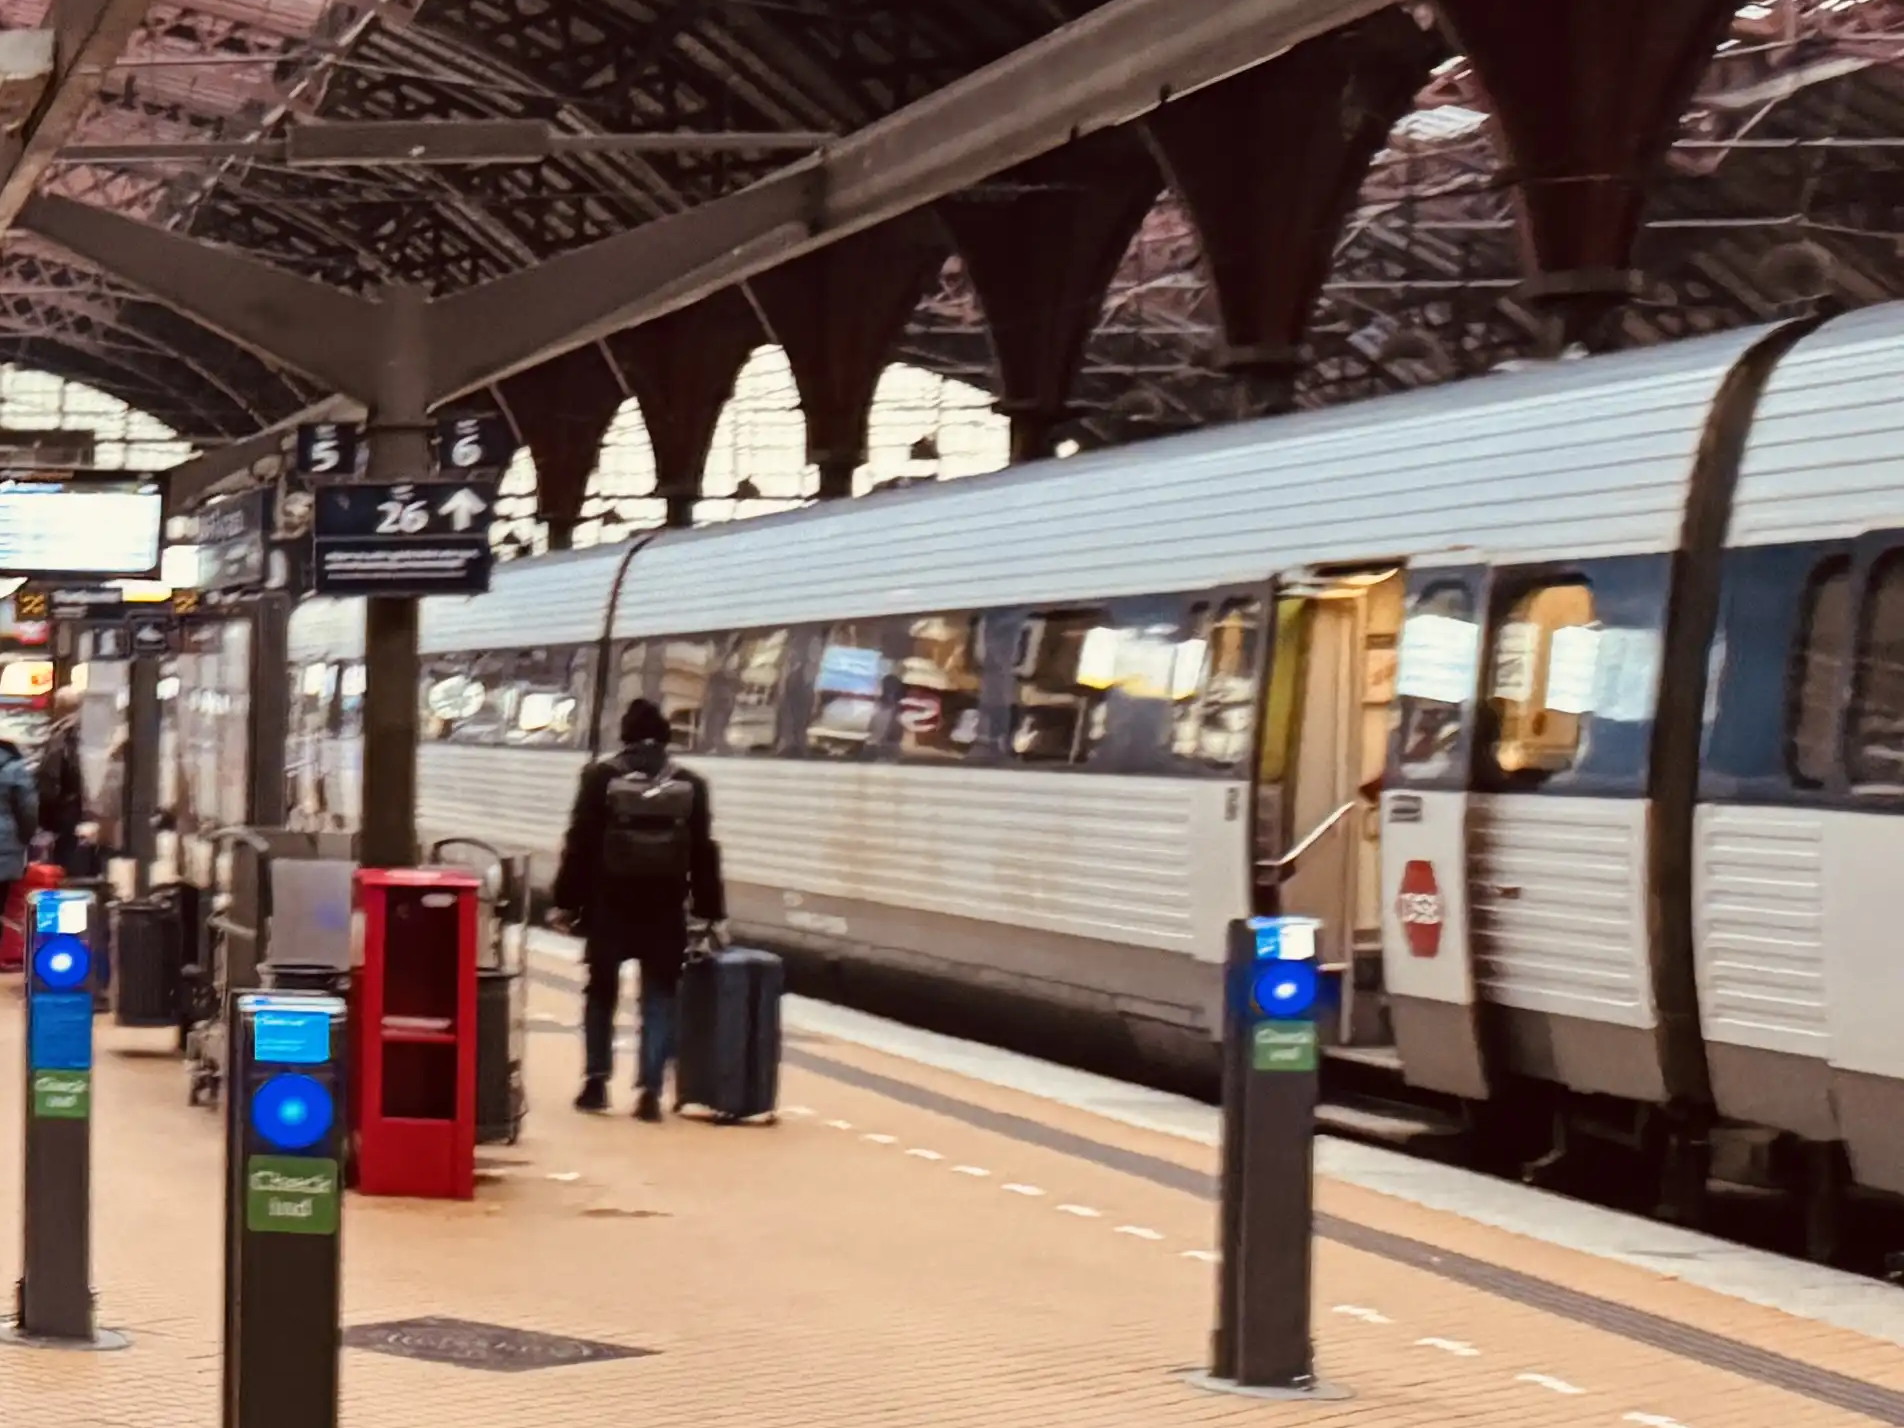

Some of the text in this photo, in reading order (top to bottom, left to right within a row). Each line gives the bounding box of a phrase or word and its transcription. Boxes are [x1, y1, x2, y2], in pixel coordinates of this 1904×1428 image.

[311, 440, 340, 472] 5
[451, 434, 483, 468] 6
[375, 500, 430, 534] 26
